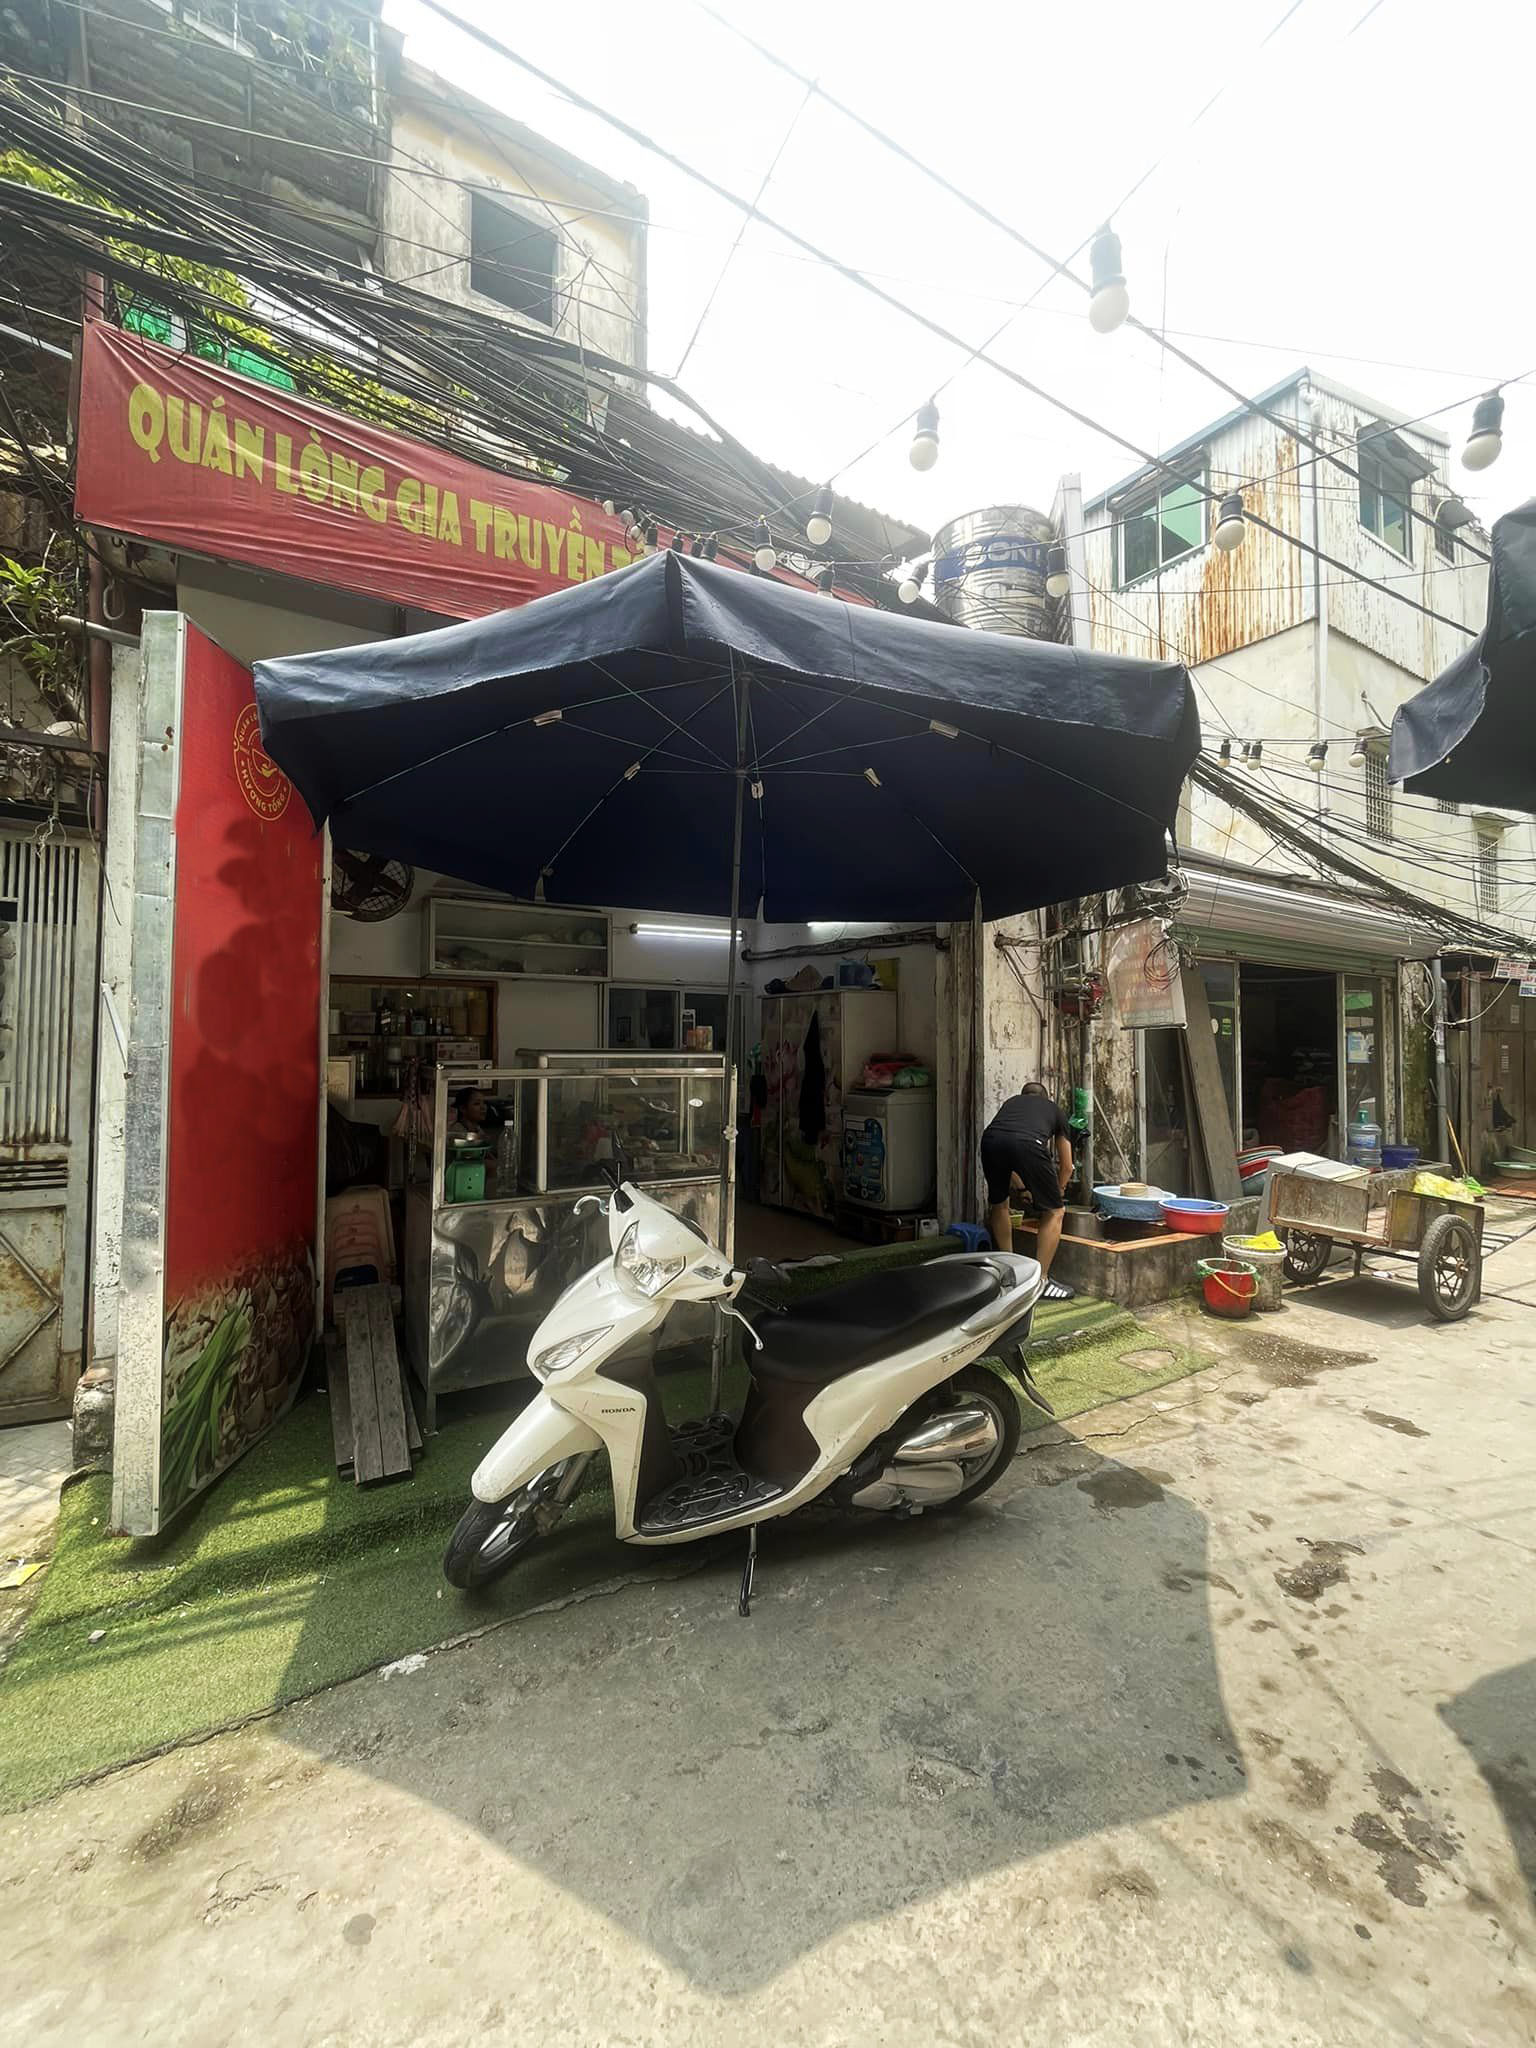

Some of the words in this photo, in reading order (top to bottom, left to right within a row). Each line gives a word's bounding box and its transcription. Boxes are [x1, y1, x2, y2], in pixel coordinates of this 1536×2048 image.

[129, 383, 265, 485] QUÁN
[275, 428, 388, 523] LÒNG
[396, 478, 463, 546] GIA
[470, 499, 606, 582] TRUYỀN
